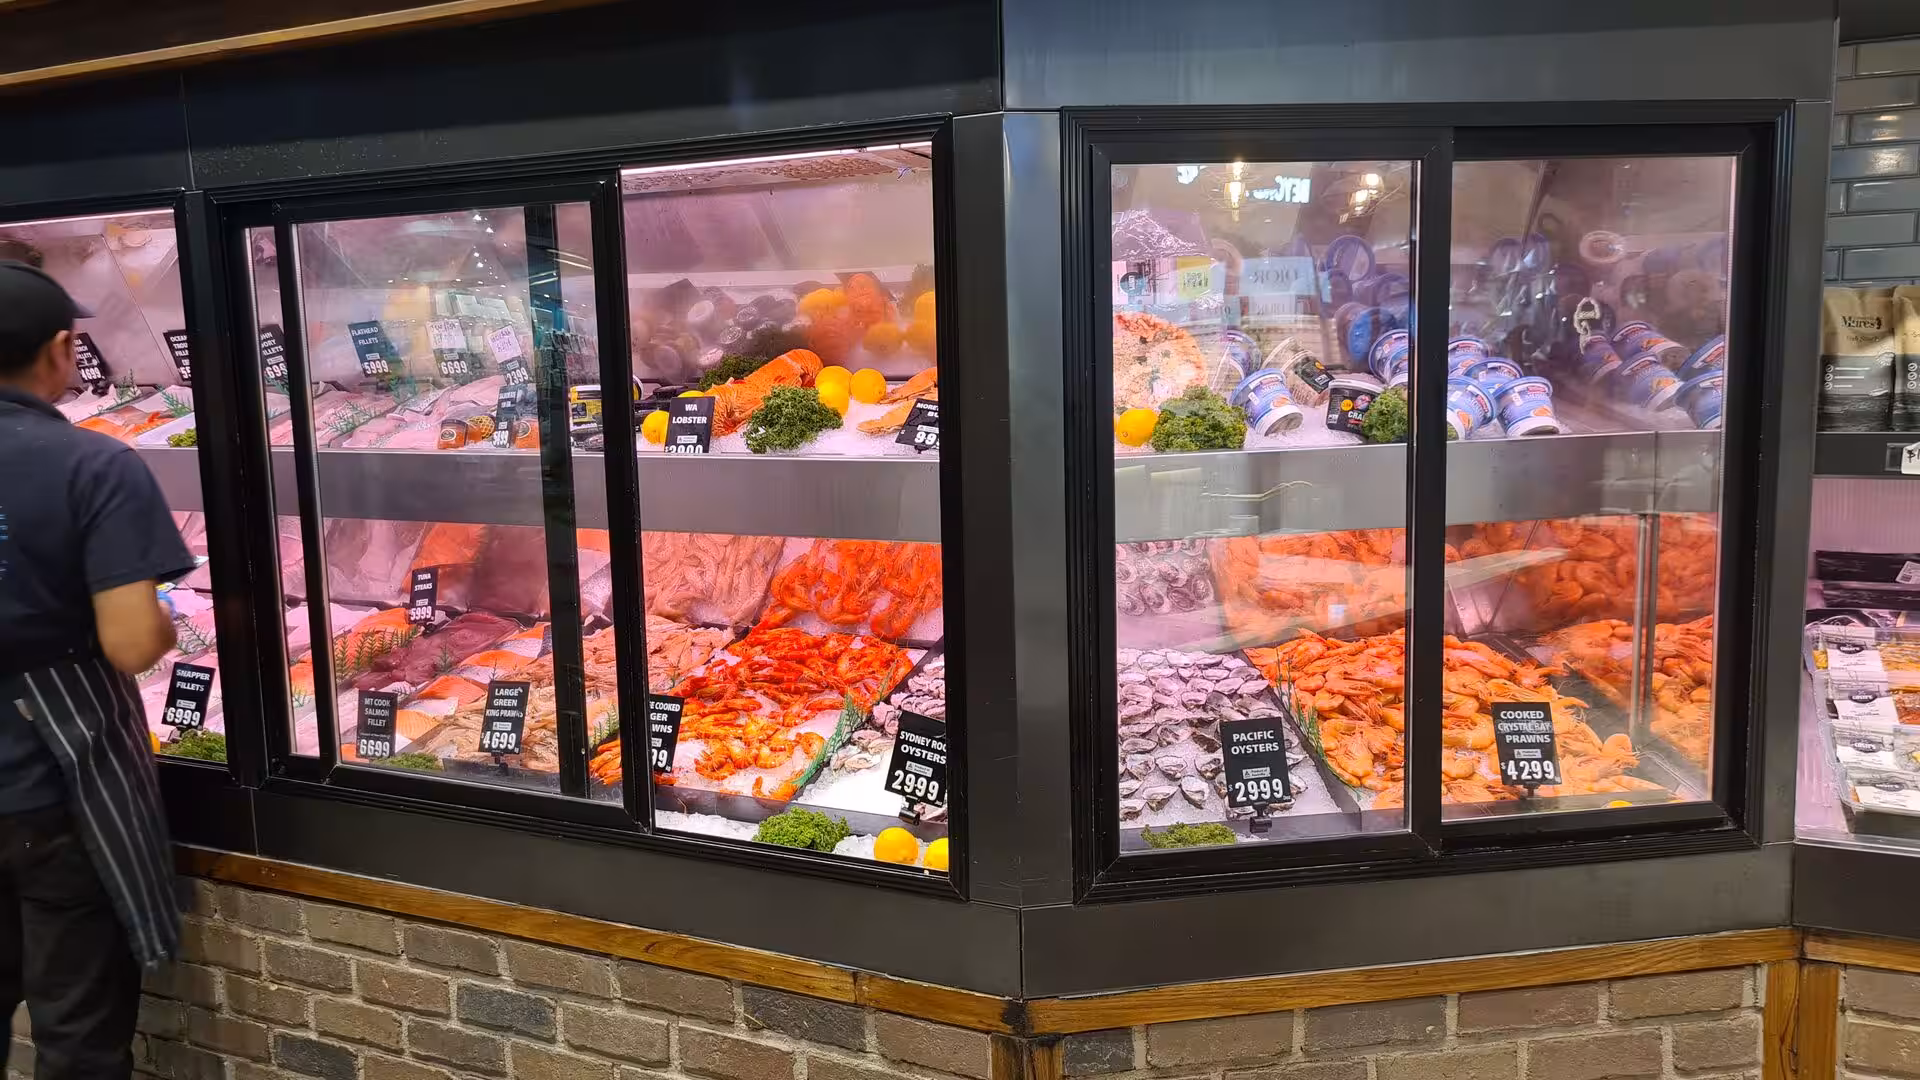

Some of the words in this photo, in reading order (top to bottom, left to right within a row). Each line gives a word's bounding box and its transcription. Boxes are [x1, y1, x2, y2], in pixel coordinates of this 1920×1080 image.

[352, 327, 379, 336] FLATHEAD
[358, 337, 379, 345] FILLETS
[685, 403, 698, 412] WA
[672, 416, 708, 424] LOBSTER
[414, 582, 433, 591] STEAKS
[176, 669, 210, 680] SNAPPER
[176, 681, 205, 691] FILLETS
[495, 688, 519, 697] LARGE
[364, 697, 373, 705] MT
[374, 699, 391, 707] COOK
[493, 698, 518, 707] GREEN
[655, 702, 681, 712] COOKED
[364, 707, 390, 717] SALMON
[485, 709, 500, 717] KING
[650, 712, 669, 722] GER
[1500, 710, 1545, 719] COOKED
[367, 718, 386, 727] FILLET
[1534, 721, 1551, 732] BAY
[651, 723, 673, 734] WNS
[900, 731, 931, 747] SYDNEY
[1232, 730, 1275, 742] PACIFIC
[1505, 733, 1551, 743] PRAWNS
[1231, 742, 1280, 755] OYSTERS
[901, 744, 947, 764] OYSTERS
